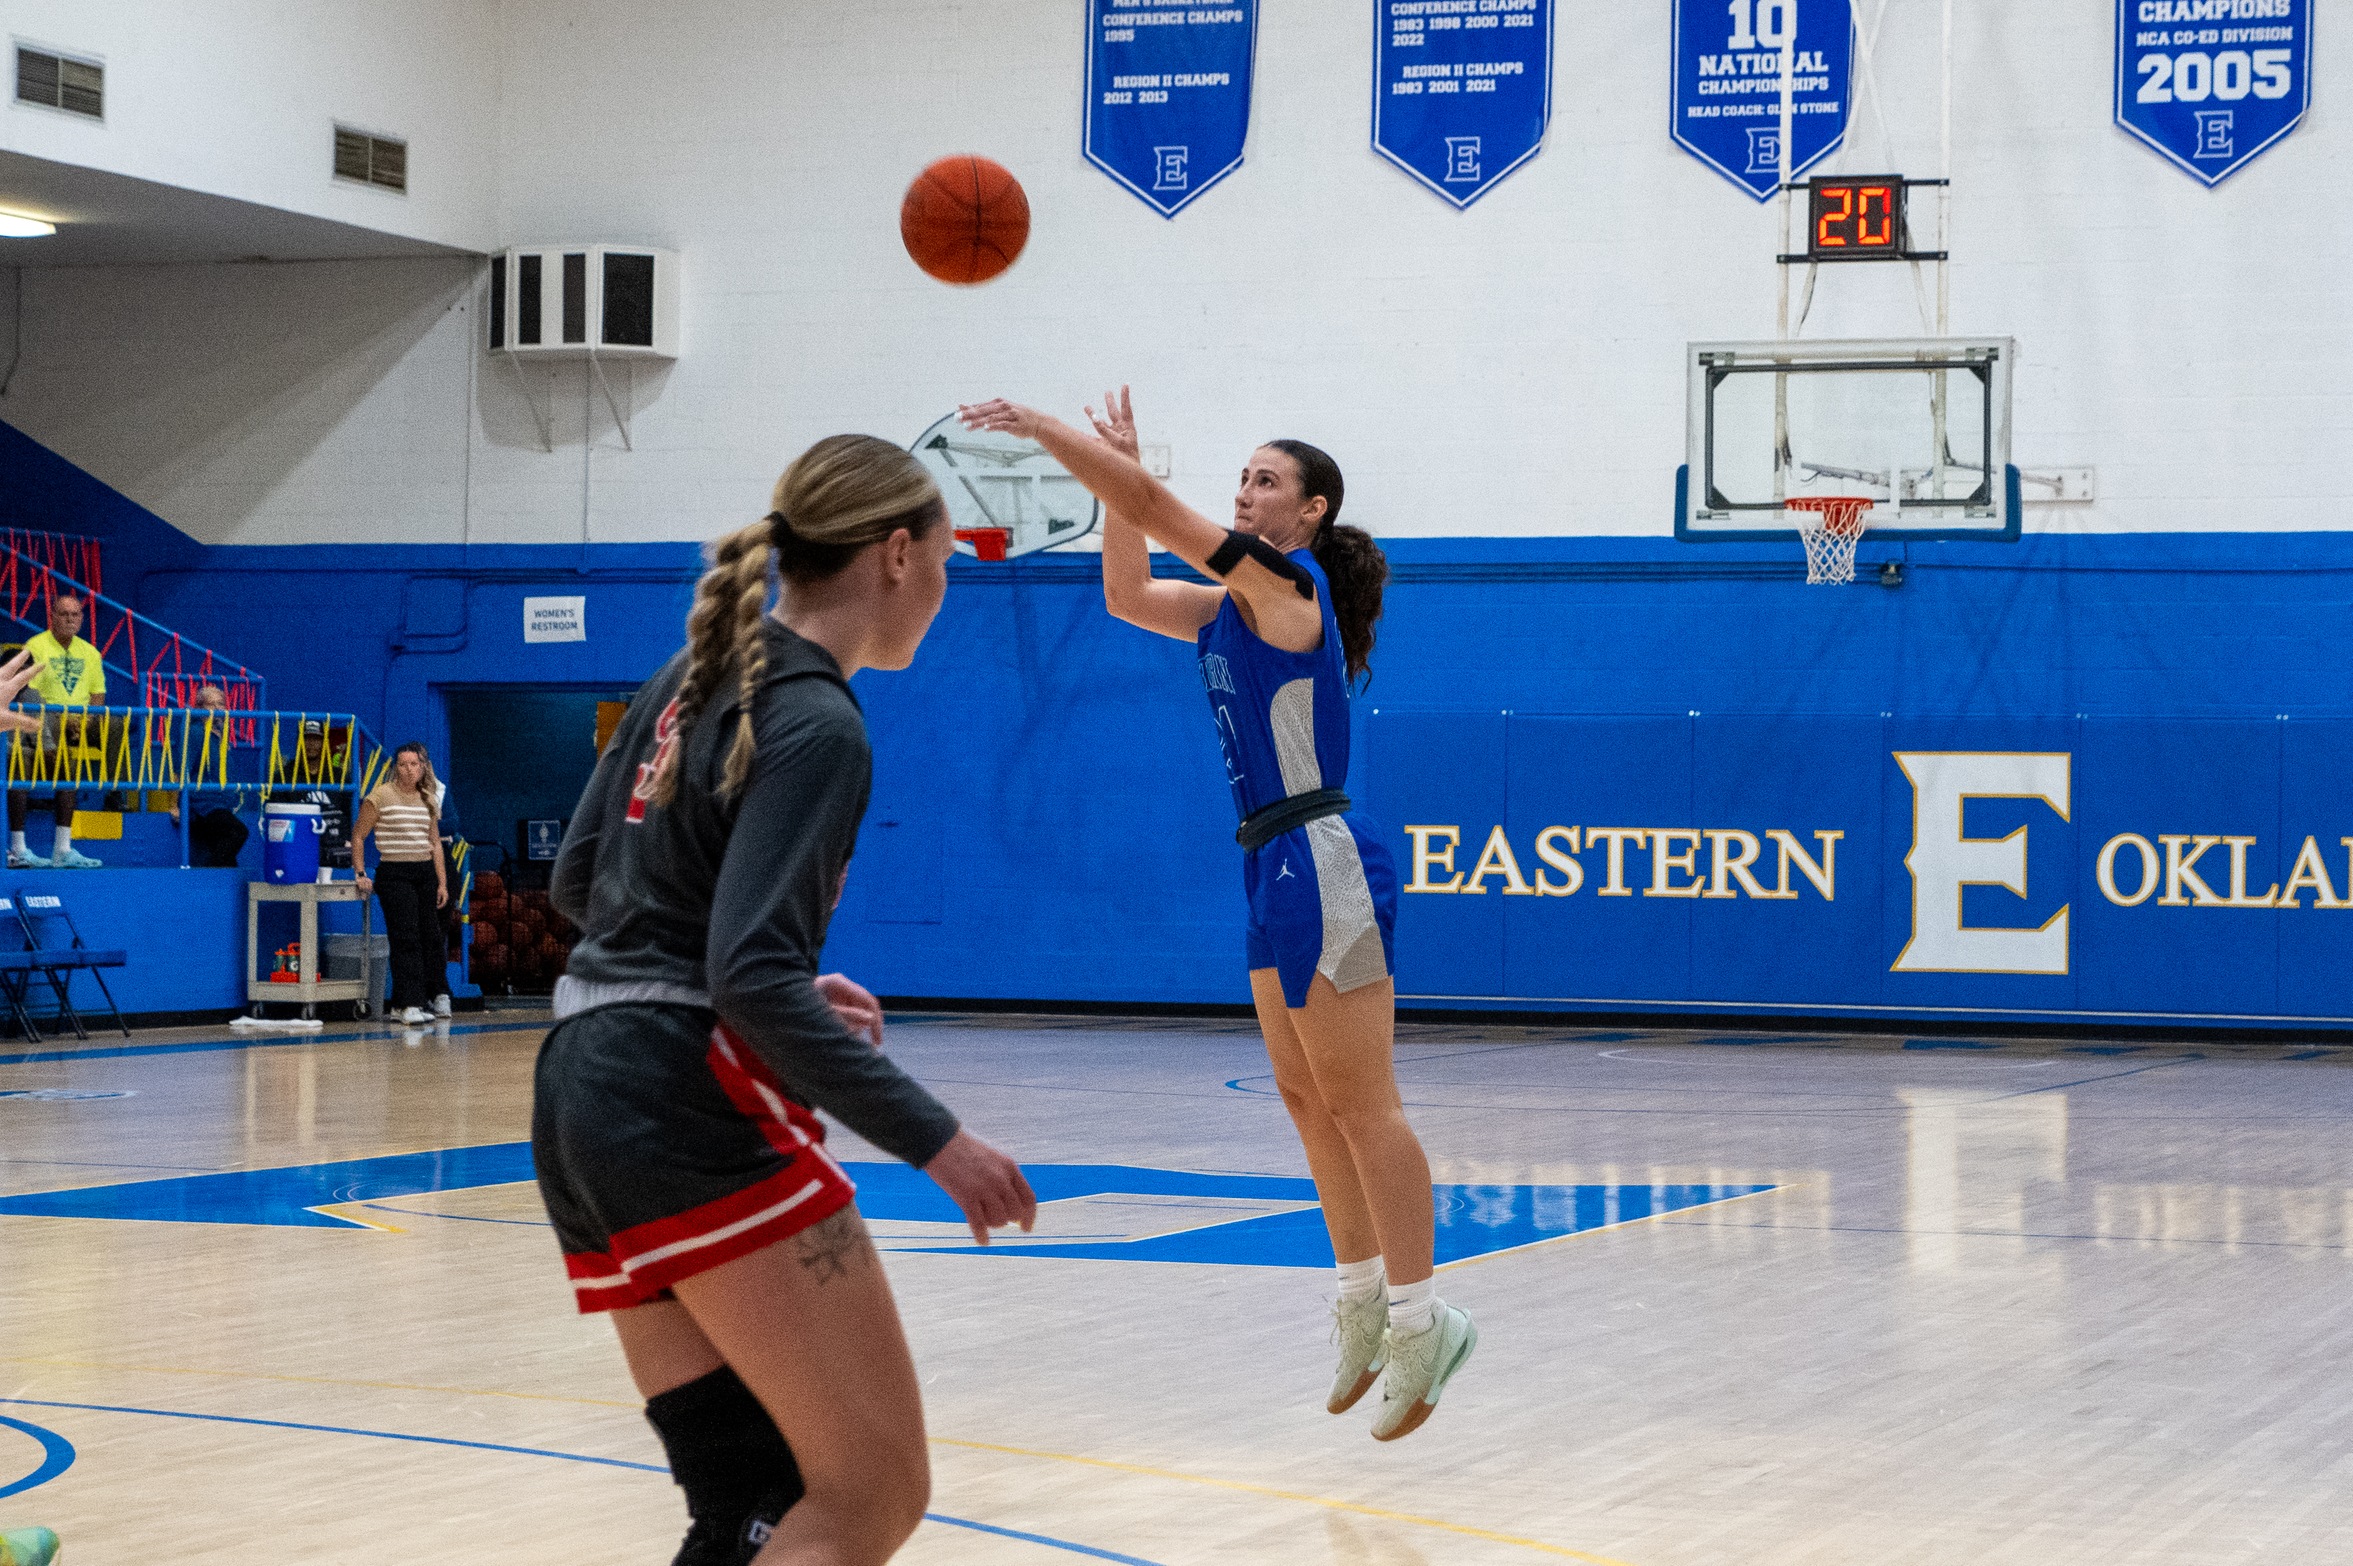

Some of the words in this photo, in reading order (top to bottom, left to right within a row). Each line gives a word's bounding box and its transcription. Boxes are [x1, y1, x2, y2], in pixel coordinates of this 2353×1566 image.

[1391, 0, 1477, 16] CONFERENCE
[1479, 0, 1537, 13] CHAMPS
[2138, 0, 2291, 23] CHAMPIONS
[1103, 12, 1185, 26] CONFERENCE
[1187, 10, 1243, 24] CHAMPS
[1465, 15, 1498, 29] 2000
[1503, 14, 1534, 27] 2021
[1728, 0, 1797, 49] 10
[1392, 33, 1424, 47] 2022
[2136, 31, 2170, 47] NCA
[2173, 29, 2219, 45] CO-ED
[2222, 26, 2293, 43] DIVISION
[1403, 65, 1451, 78] REGION
[1454, 64, 1463, 77] II
[1466, 62, 1524, 76] CHAMPS
[1699, 51, 1829, 76] NATIOAL
[1113, 74, 1161, 88] REGION
[1162, 74, 1172, 87] II
[1174, 72, 1230, 87] CHAMPS
[2136, 48, 2292, 104] 2005
[1428, 80, 1459, 93] 2001
[1466, 79, 1496, 92] 2021
[1698, 76, 1829, 95] CHAMPIONHIPS
[1103, 92, 1133, 105] 2012
[1138, 91, 1168, 104] 2013
[1688, 105, 1720, 118] HEAD
[1722, 104, 1765, 117] COACH:
[2193, 110, 2233, 159] E
[1444, 136, 1481, 182] E
[1153, 146, 1188, 190] E
[1818, 187, 1891, 246] 20
[534, 609, 575, 618] WOMEN'S
[531, 621, 578, 631] RESTROOM
[1404, 824, 1844, 901] EASTERN
[1889, 751, 2071, 975] E
[2096, 832, 2353, 909] OKLA
